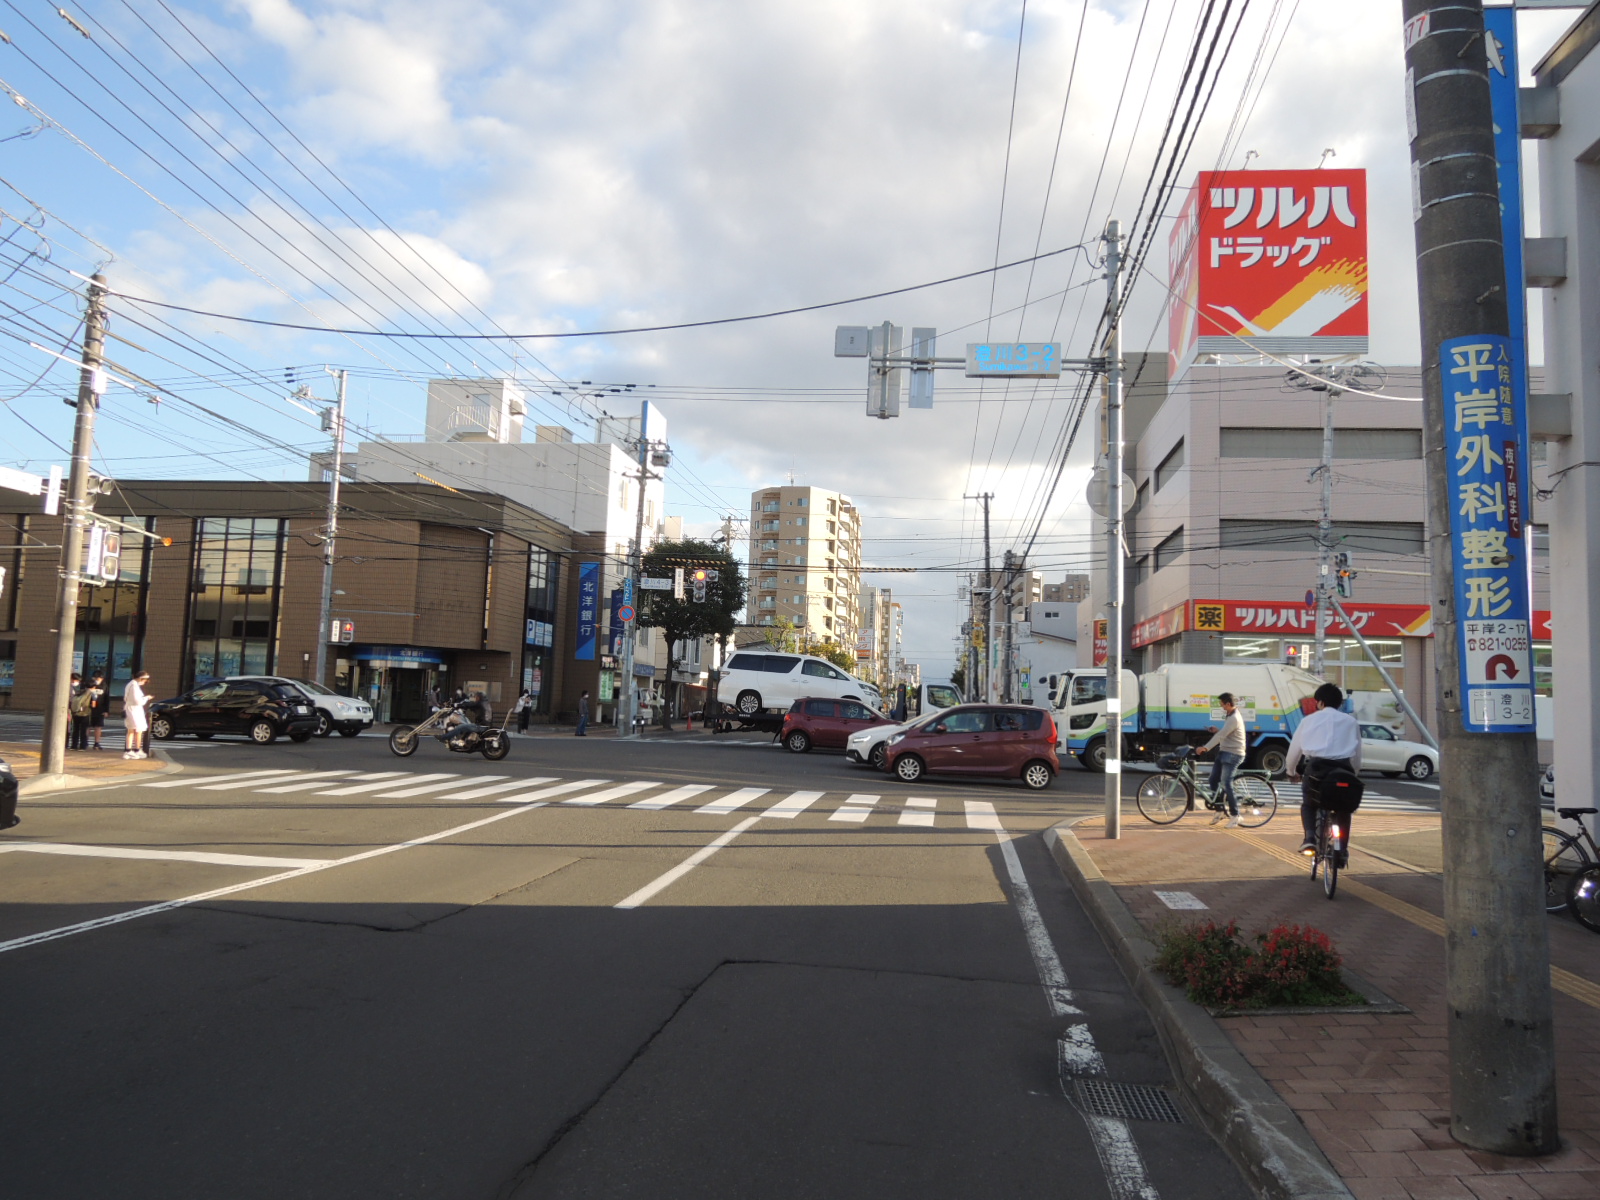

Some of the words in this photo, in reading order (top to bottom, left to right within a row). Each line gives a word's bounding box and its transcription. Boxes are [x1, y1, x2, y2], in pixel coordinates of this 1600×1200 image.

[1210, 186, 1357, 229] ツルハ
[1210, 236, 1332, 269] ドラッグ
[1450, 343, 1513, 617] 平岸外科整形
[580, 582, 594, 636] 北洋銀行
[1198, 606, 1222, 628] 薬
[1467, 623, 1526, 635] 平岸2-17
[1502, 708, 1530, 720] 3-2
